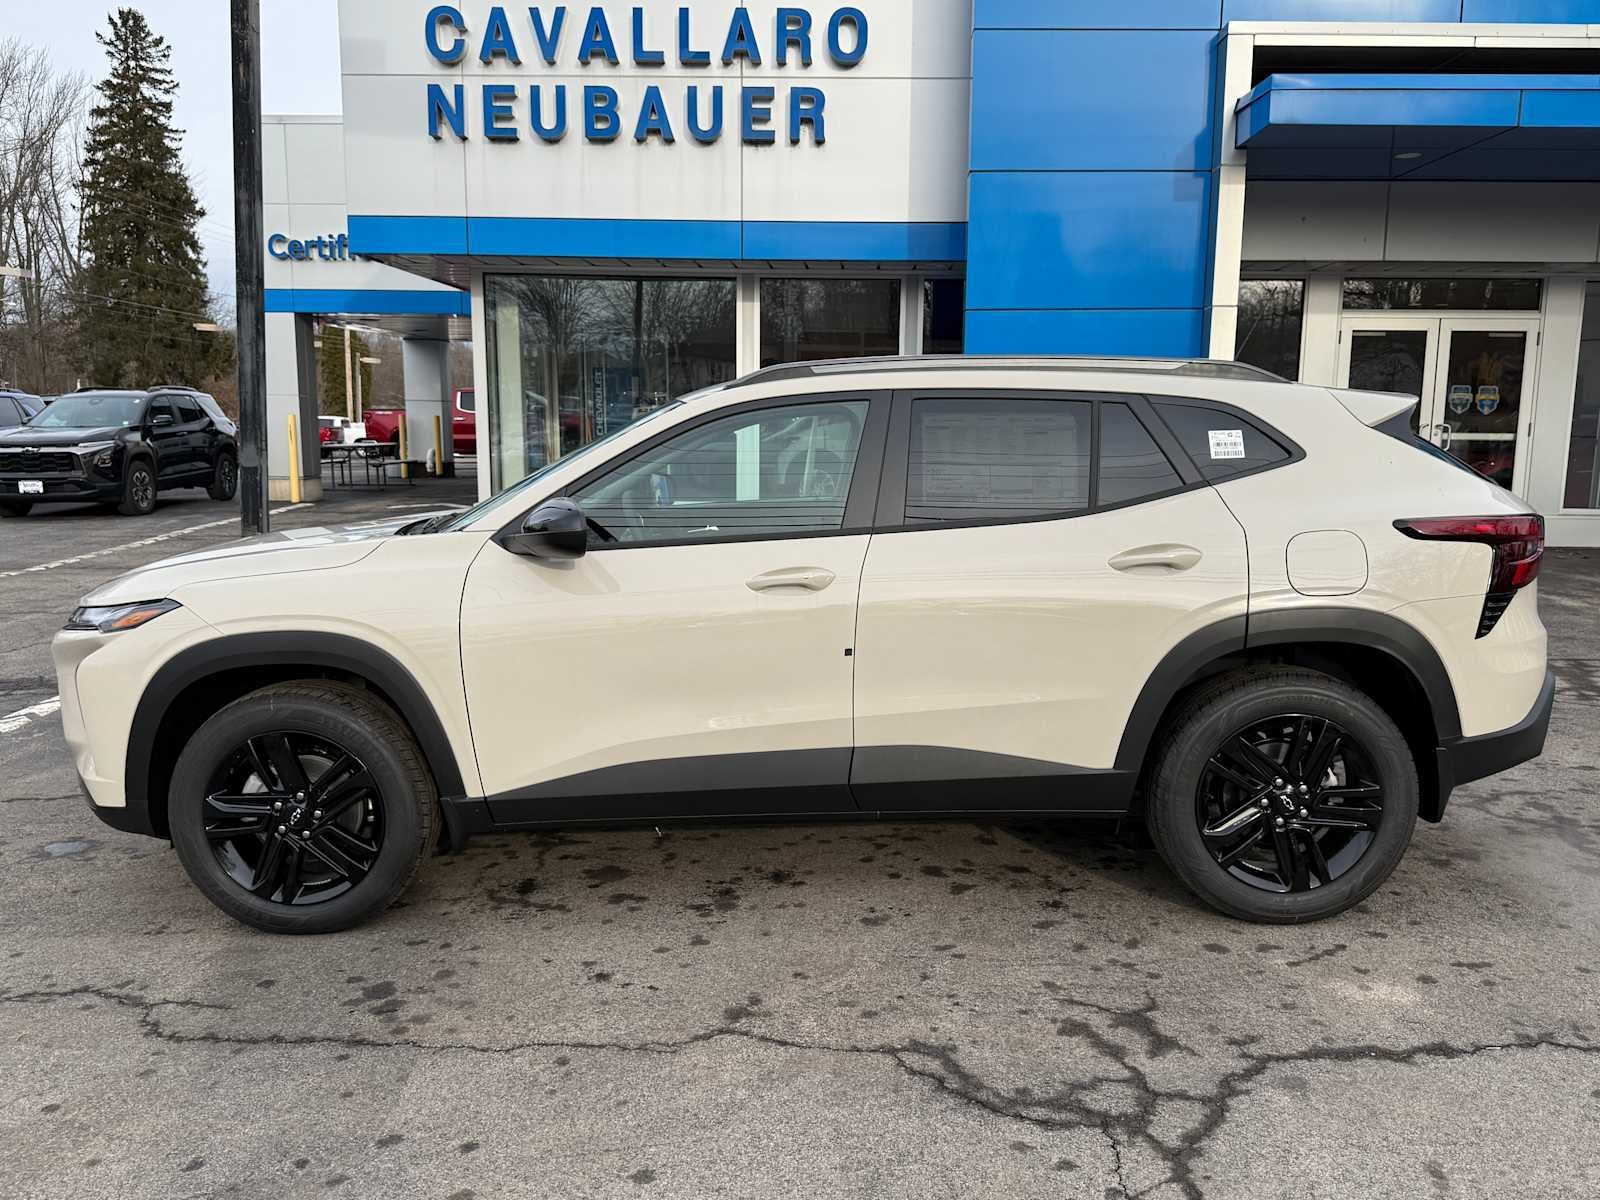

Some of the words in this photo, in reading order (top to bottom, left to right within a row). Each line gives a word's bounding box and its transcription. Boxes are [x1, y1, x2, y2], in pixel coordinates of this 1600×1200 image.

[425, 6, 868, 68] CAVALLARO
[427, 84, 826, 147] NEUBAUER
[268, 232, 353, 261] Certif
